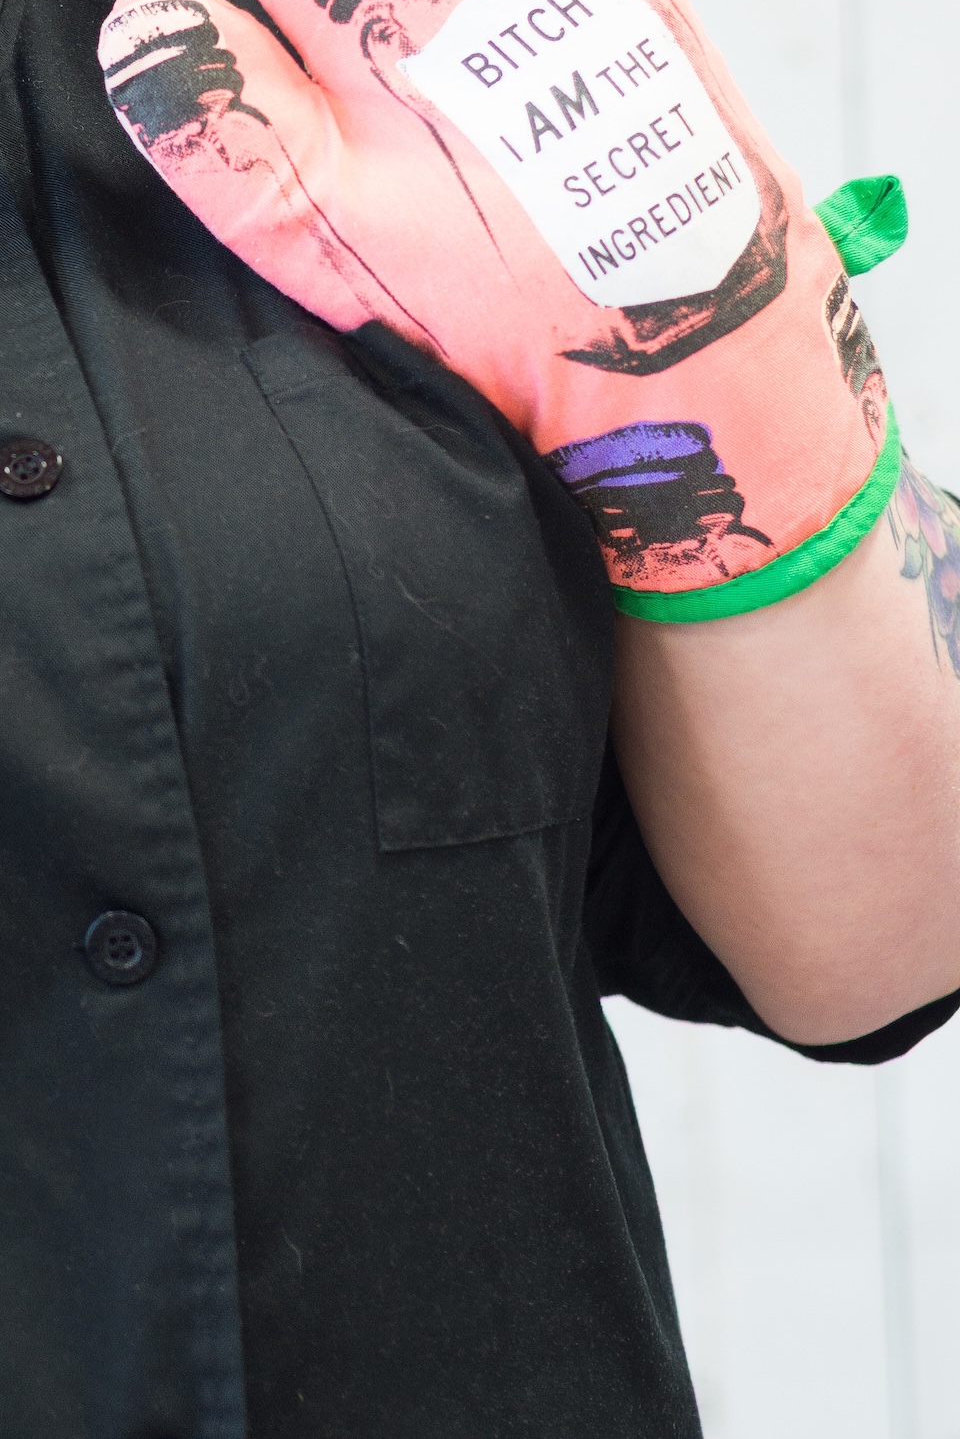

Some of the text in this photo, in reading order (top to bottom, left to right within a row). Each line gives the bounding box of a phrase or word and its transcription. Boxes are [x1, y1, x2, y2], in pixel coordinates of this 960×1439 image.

[499, 37, 669, 163] I AM THE
[563, 102, 695, 209] SECRET
[577, 151, 741, 282] INGREDIENT
